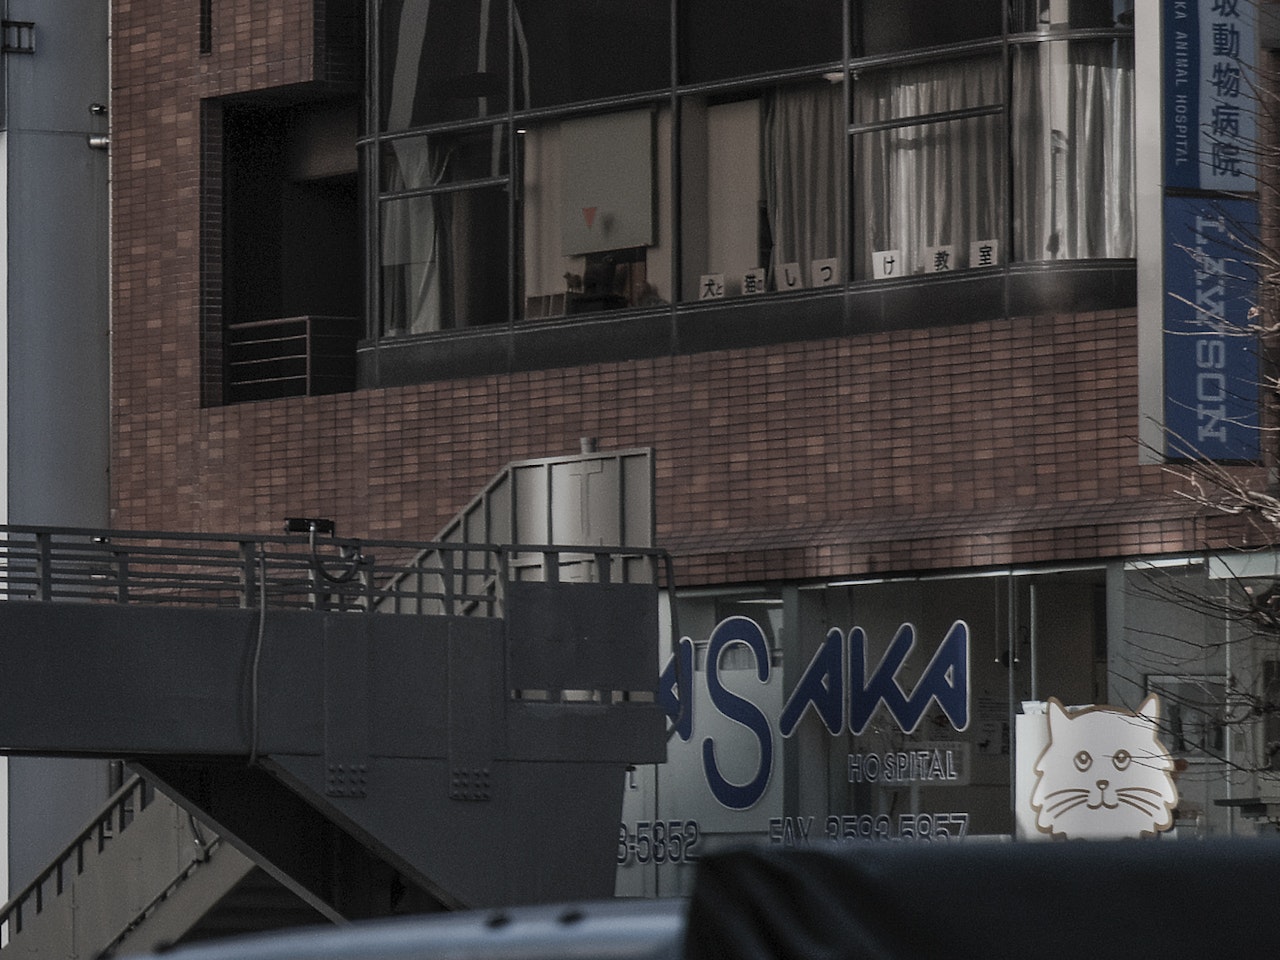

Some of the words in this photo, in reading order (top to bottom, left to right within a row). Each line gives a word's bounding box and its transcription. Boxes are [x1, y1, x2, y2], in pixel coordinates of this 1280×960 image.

[1175, 31, 1190, 87] ANIMAL
[1174, 94, 1190, 167] HOSPITAL
[1195, 215, 1227, 443] LAWSON
[848, 748, 958, 783] HOSPITAL
